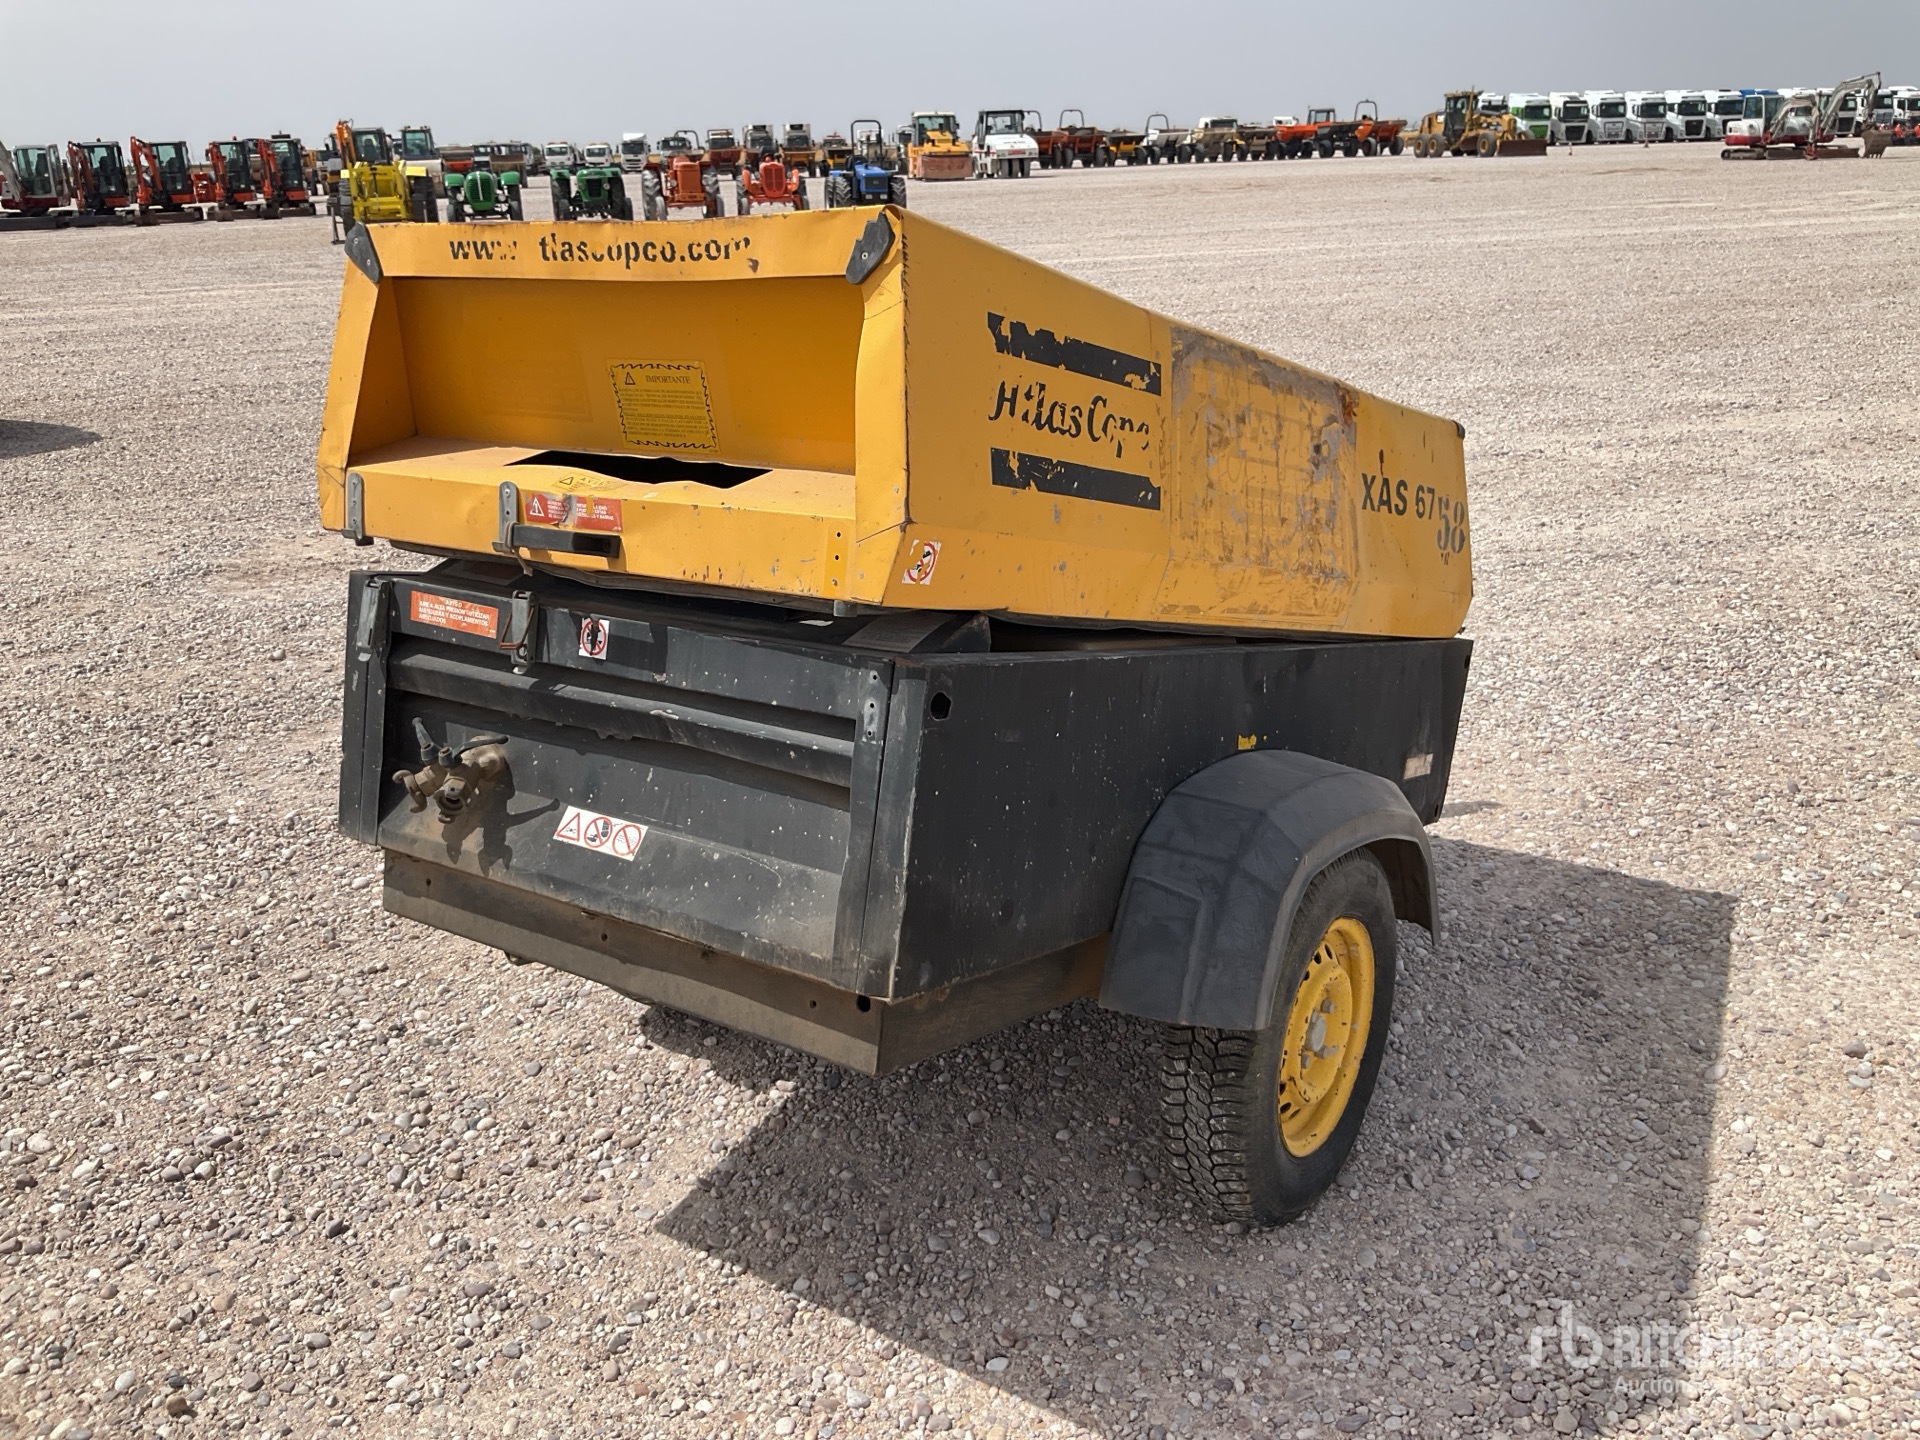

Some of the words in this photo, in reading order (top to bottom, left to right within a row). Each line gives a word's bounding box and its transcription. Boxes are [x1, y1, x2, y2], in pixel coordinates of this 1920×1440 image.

[645, 375, 691, 385] IMPORTANTE
[1361, 472, 1408, 517] XAS
[1415, 484, 1435, 520] 67
